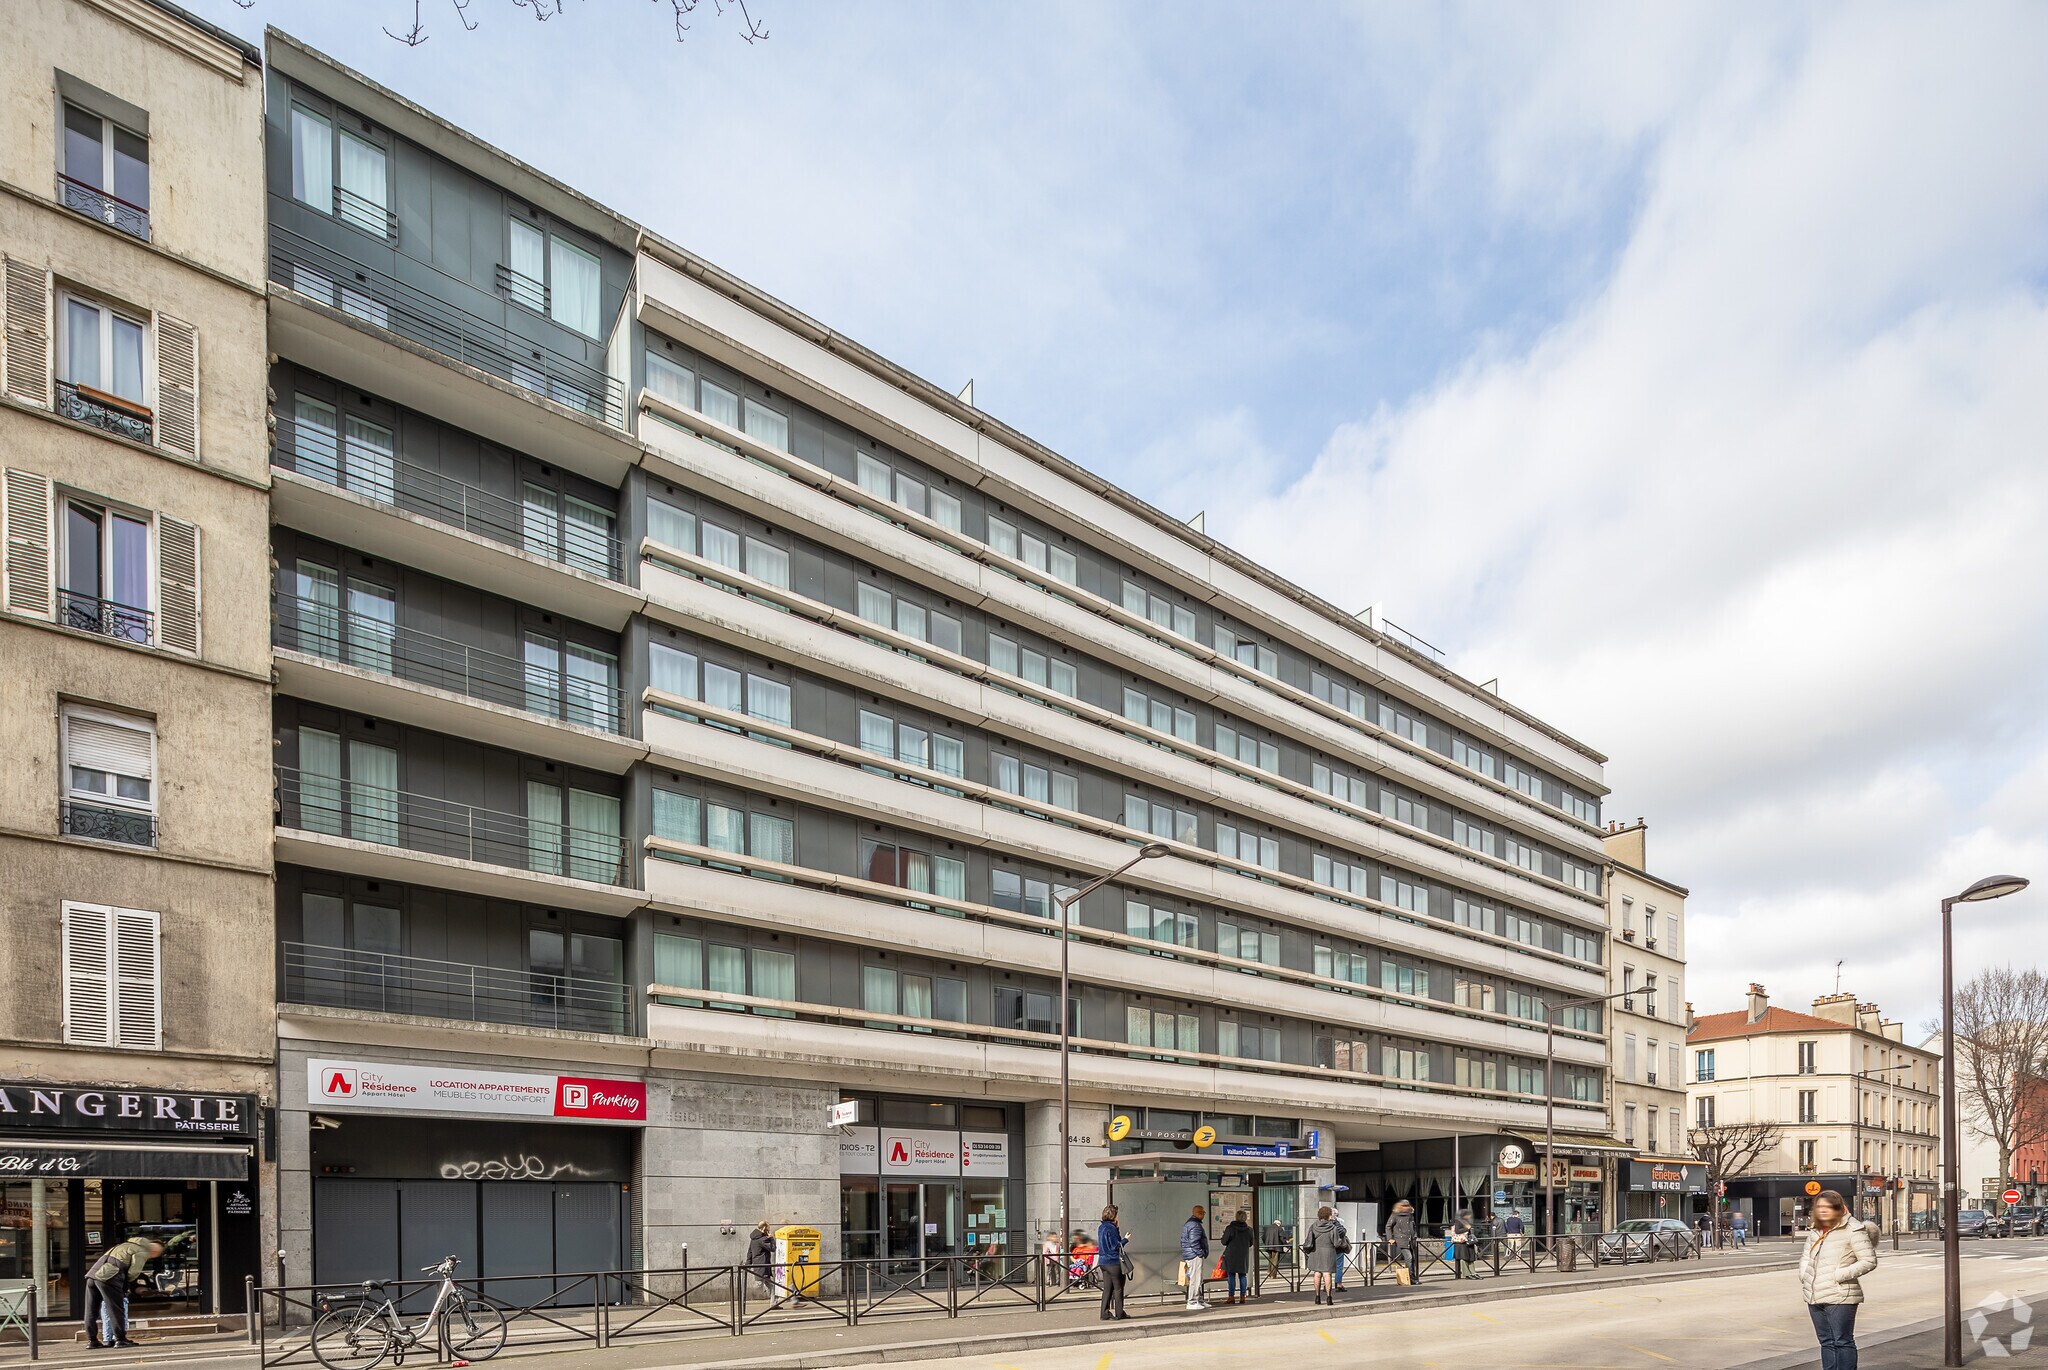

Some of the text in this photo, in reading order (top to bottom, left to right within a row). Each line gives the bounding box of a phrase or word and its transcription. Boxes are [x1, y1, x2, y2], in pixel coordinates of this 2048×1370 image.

[361, 1072, 383, 1083] City
[362, 1082, 417, 1093] Résidence
[430, 1080, 550, 1094] LOCATION APPARTEMENTS
[433, 1090, 547, 1103] MEUBLÉS TOUT CONFORT
[592, 1092, 639, 1113] Parking
[175, 1119, 240, 1131] PÂTISSERIE
[914, 1140, 930, 1150] City
[915, 1150, 955, 1159] Résidence
[0, 1156, 81, 1171] Blé d'Or
[1652, 1168, 1681, 1181] fenêtres
[1652, 1181, 1658, 1190] 01
